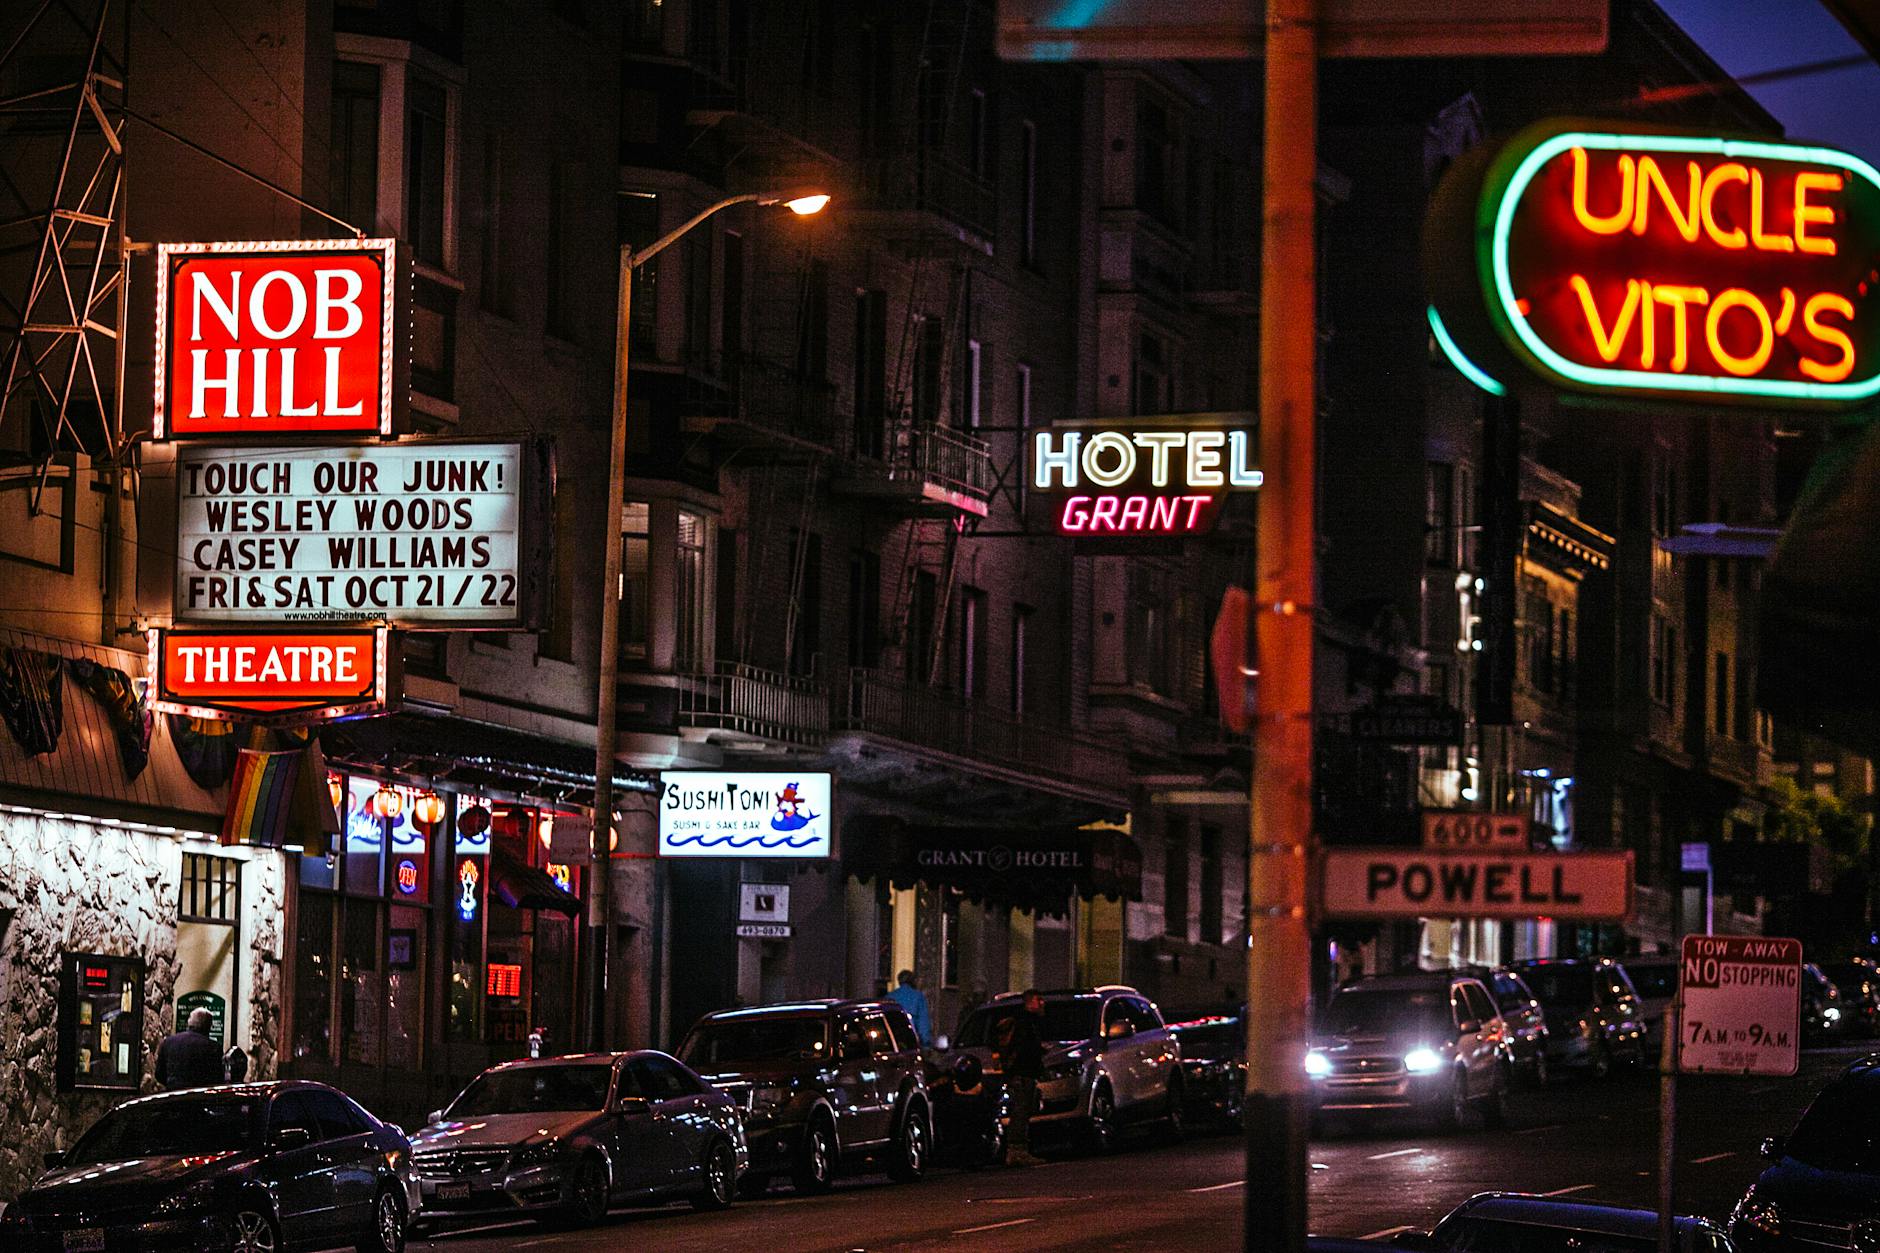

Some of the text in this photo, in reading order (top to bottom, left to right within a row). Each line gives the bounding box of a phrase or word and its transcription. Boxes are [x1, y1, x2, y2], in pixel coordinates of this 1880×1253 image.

[1570, 145, 1843, 255] UNCLE
[189, 268, 364, 342] NOB
[1570, 274, 1855, 383] VITO'S
[188, 346, 364, 419] HILL
[1035, 431, 1264, 487] HOTEL
[185, 460, 503, 494] TOUCH OUR JUNK!
[206, 498, 473, 533] WESLEY WOODS
[1061, 495, 1213, 531] GRANT
[193, 535, 491, 571] CASEY WILLIAMS
[345, 575, 409, 607] OCT
[284, 611, 387, 620] www.nobhilltheatre.com
[177, 646, 358, 684] THEATRE
[673, 820, 700, 830] SUSHI
[716, 820, 738, 830] SAKE
[743, 820, 761, 830] BAR
[1432, 816, 1492, 844] 600
[916, 849, 987, 866] GRANT
[1015, 850, 1083, 867] HOTEL
[1366, 863, 1582, 905] POWELL
[1694, 940, 1729, 956] TOW
[1743, 942, 1790, 958] AWAY
[1685, 957, 1797, 988] NO STOPPING
[1734, 1030, 1747, 1042] TO
